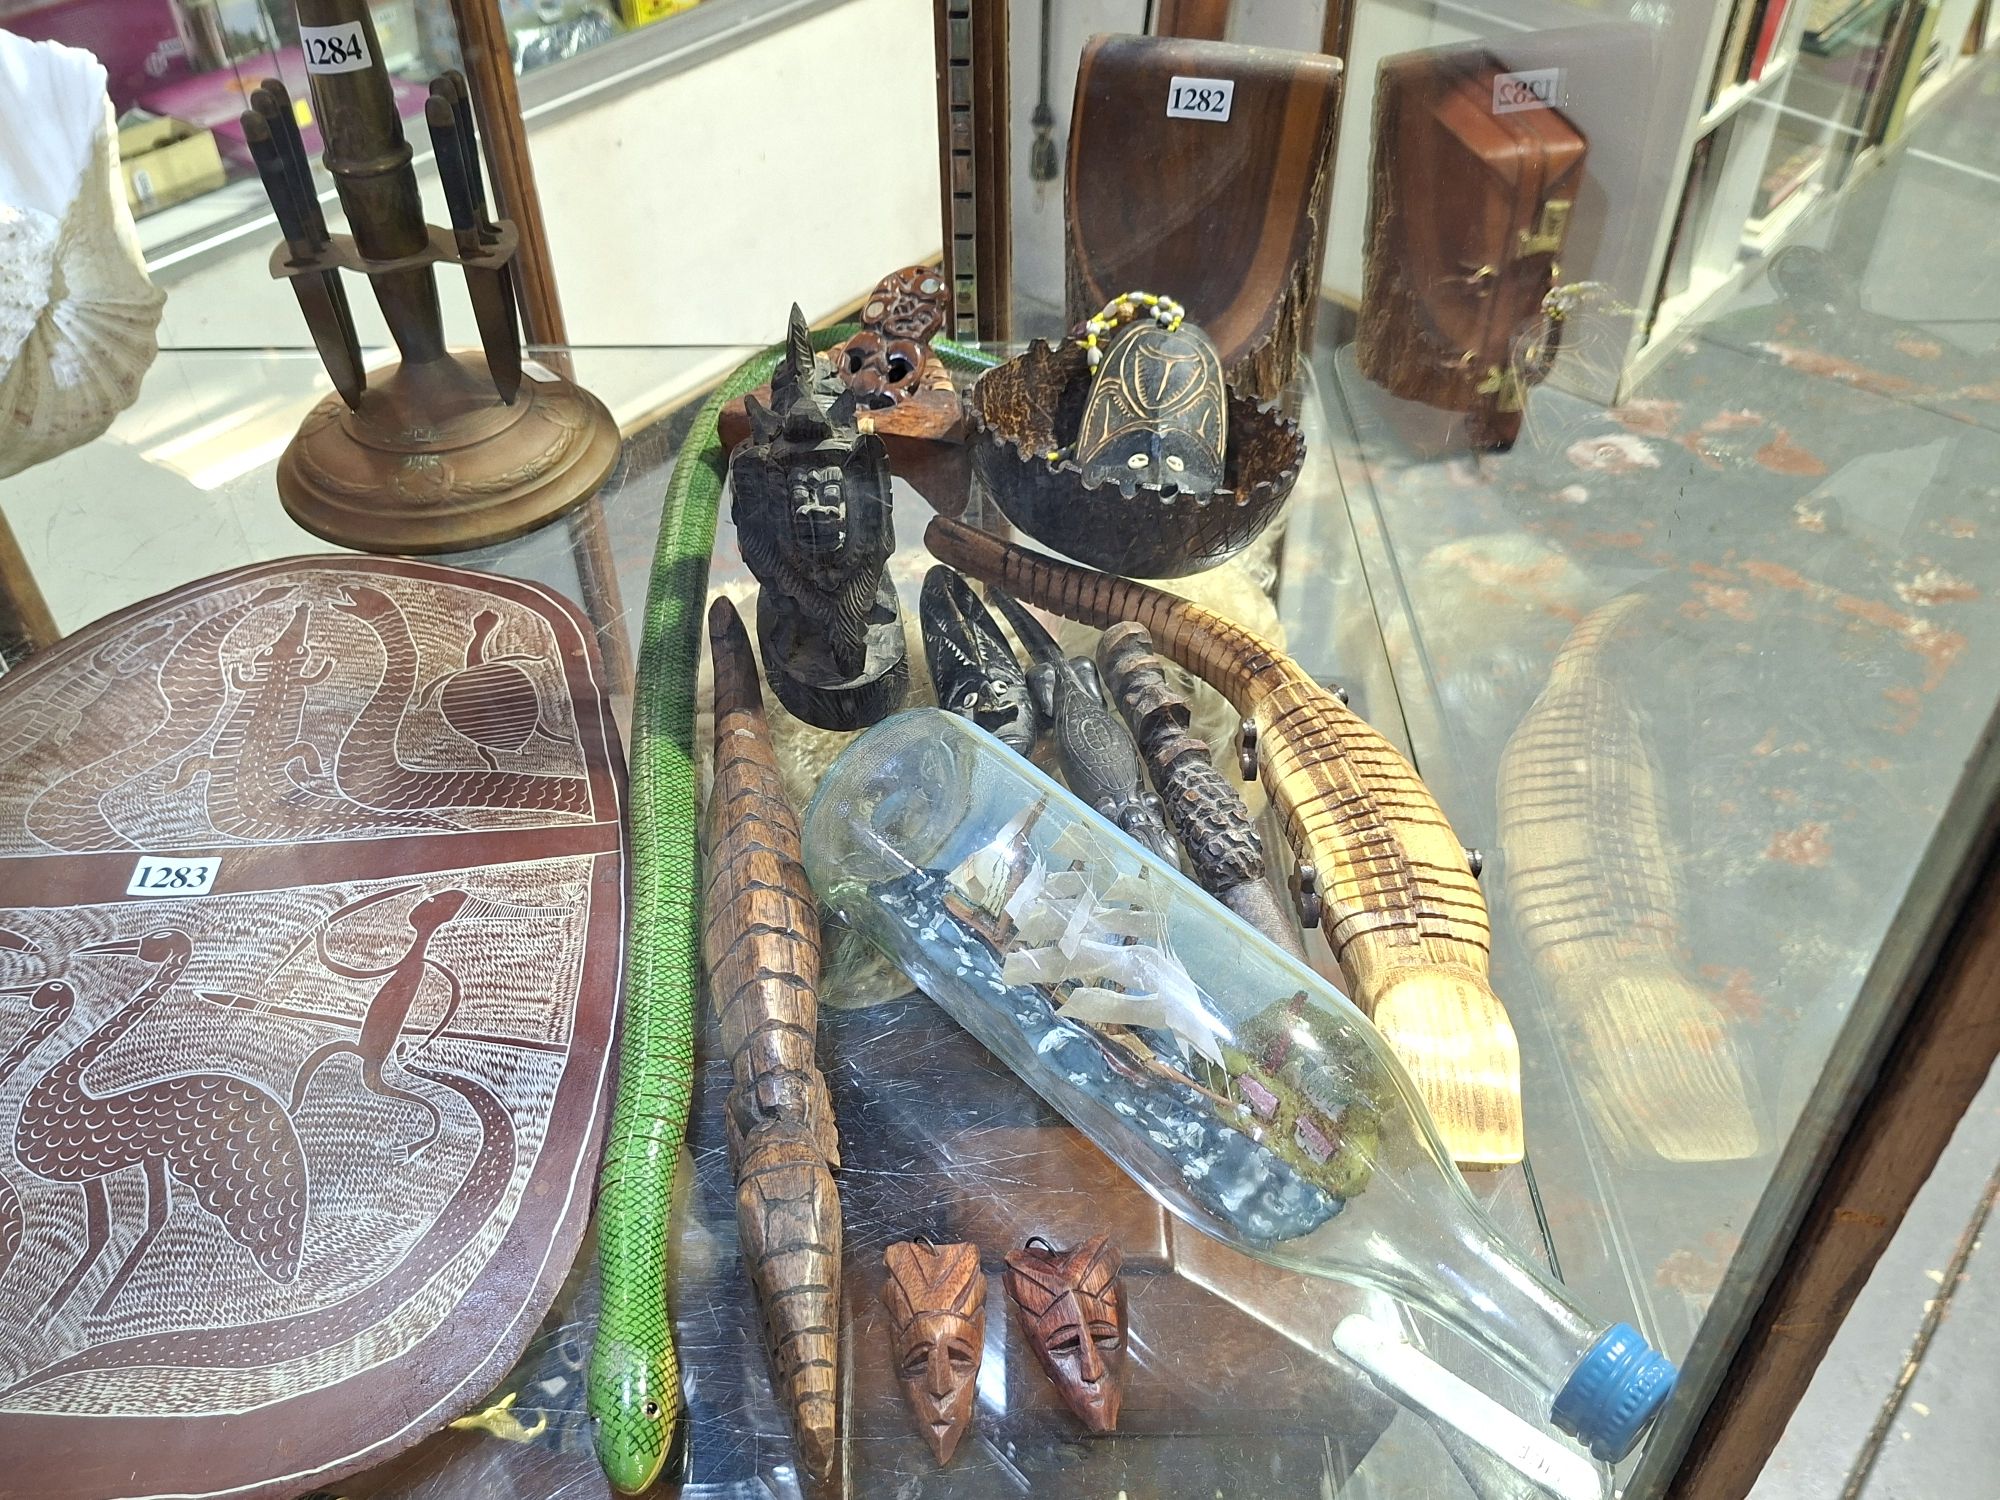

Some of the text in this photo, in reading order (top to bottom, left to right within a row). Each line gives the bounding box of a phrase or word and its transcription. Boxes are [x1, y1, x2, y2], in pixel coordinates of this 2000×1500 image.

[305, 33, 362, 65] 1284
[1171, 87, 1225, 112] 1282
[133, 866, 209, 888] 1283
